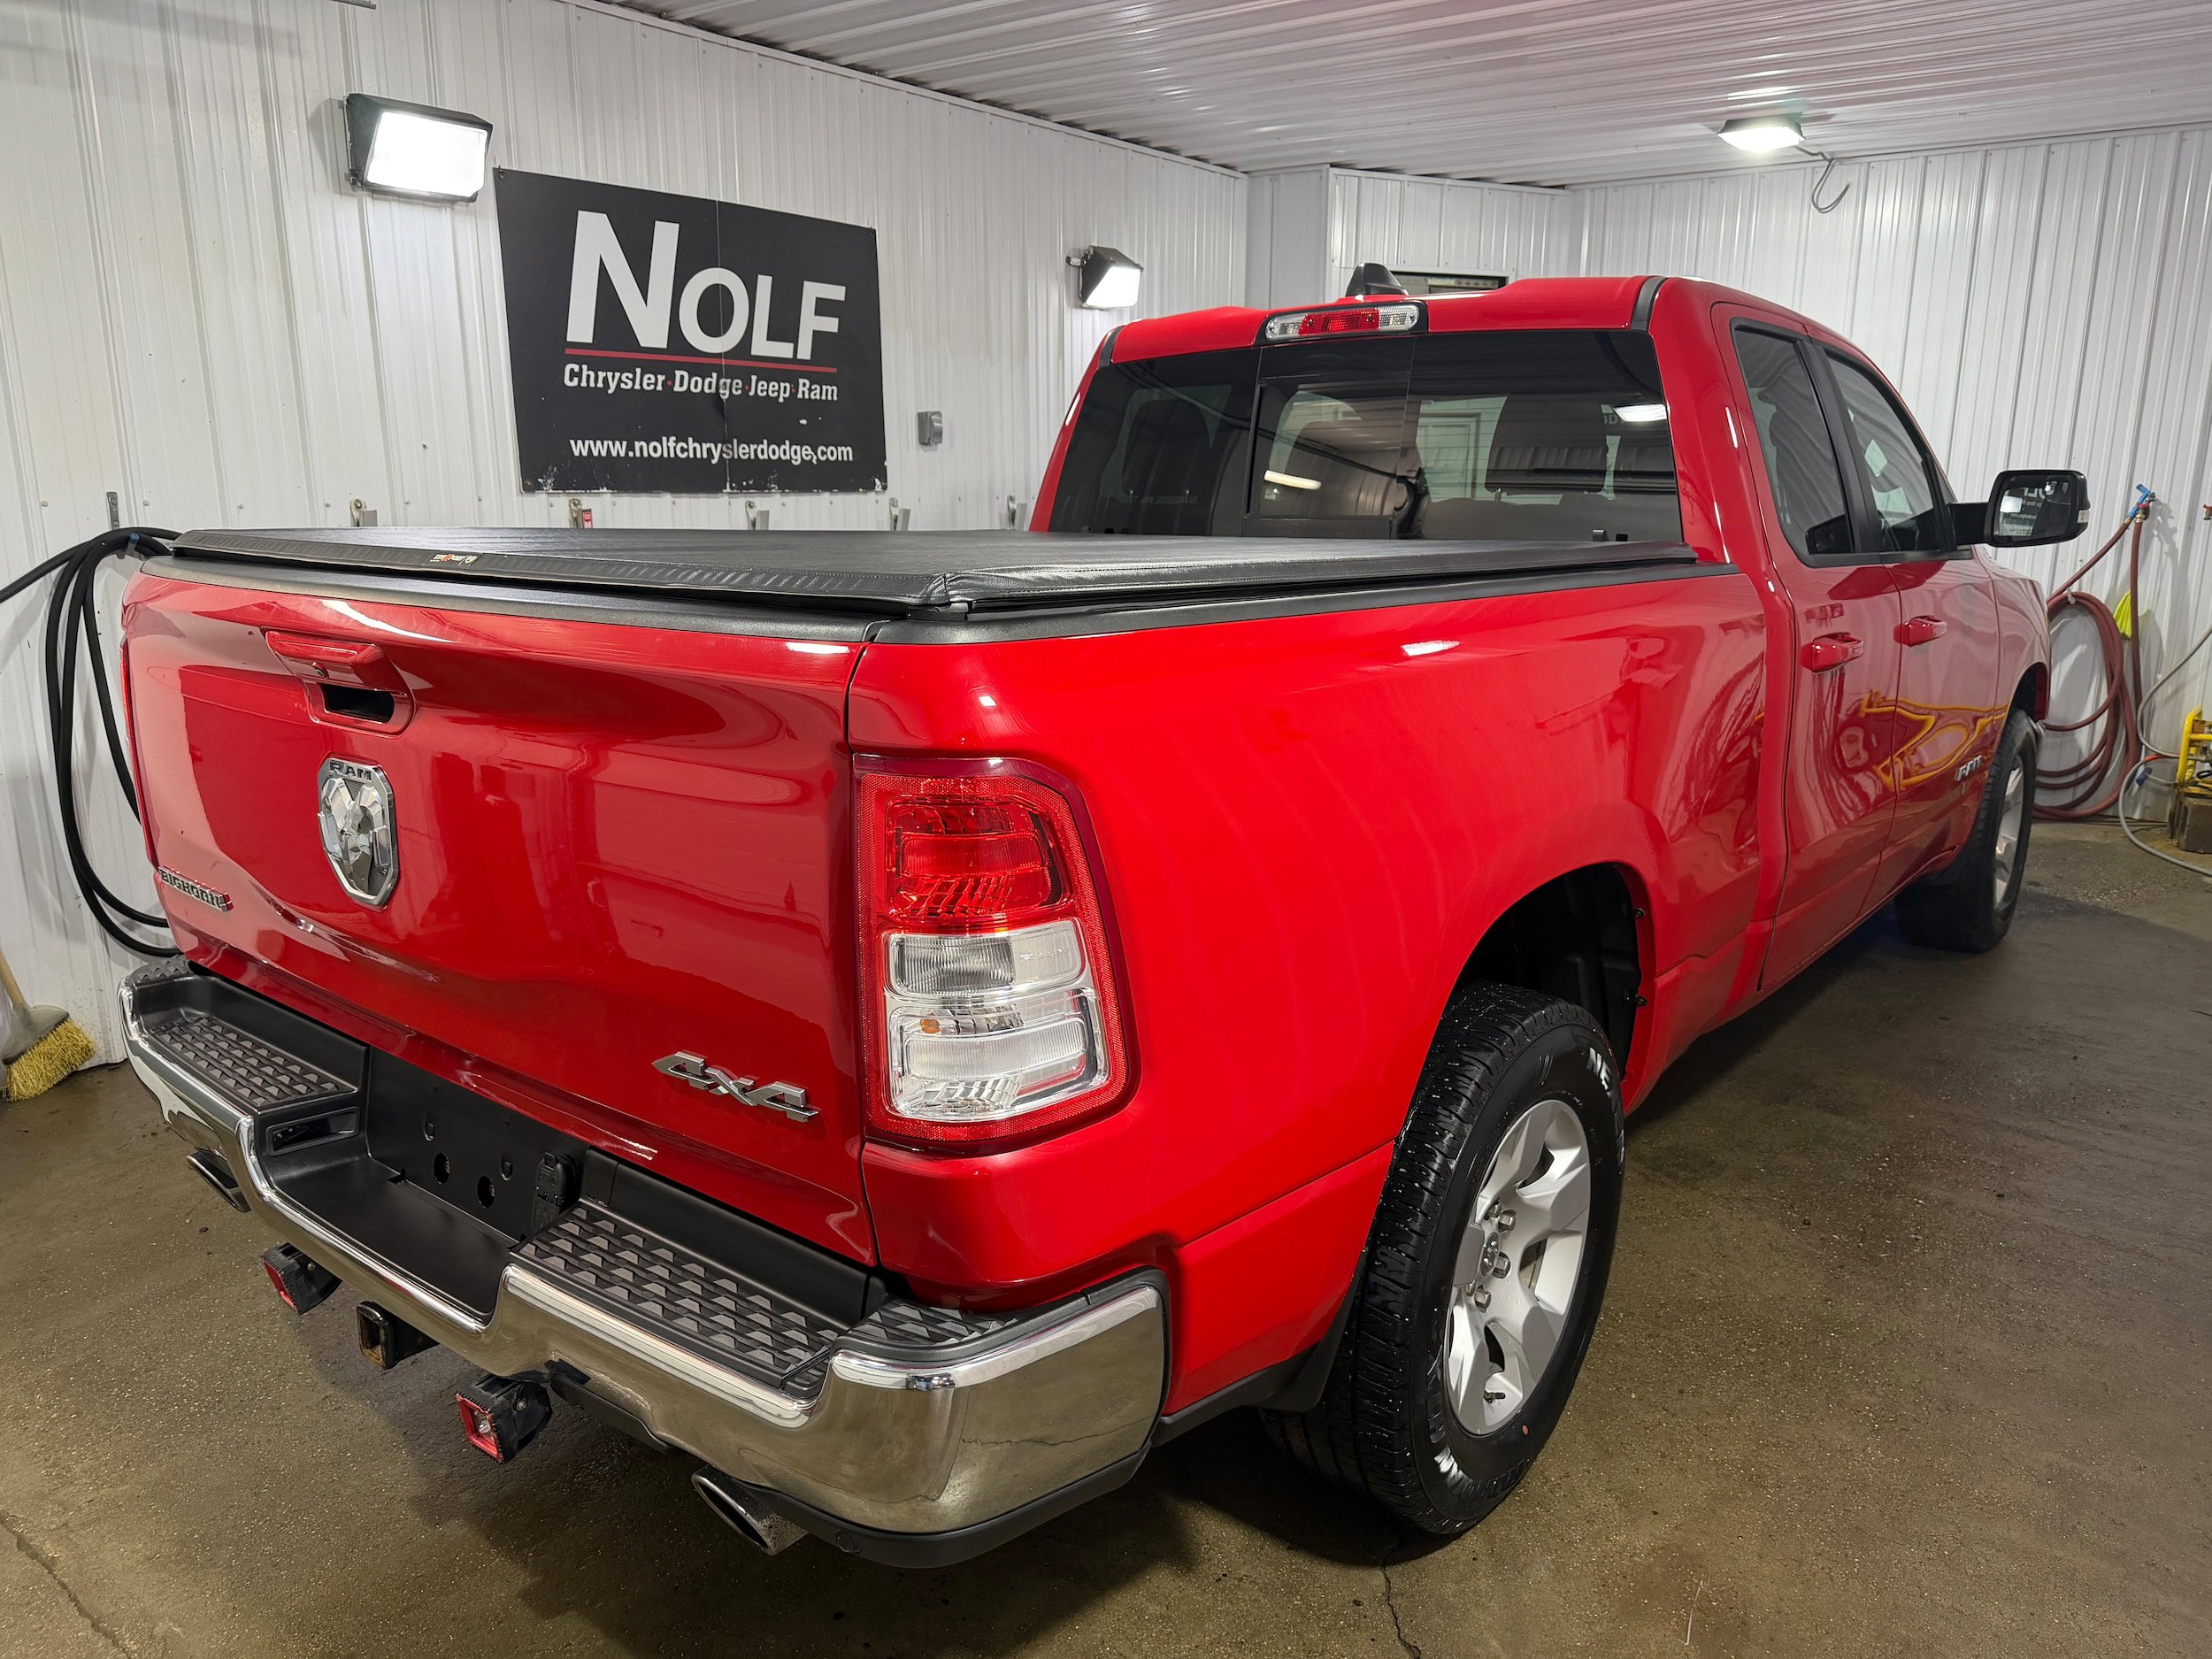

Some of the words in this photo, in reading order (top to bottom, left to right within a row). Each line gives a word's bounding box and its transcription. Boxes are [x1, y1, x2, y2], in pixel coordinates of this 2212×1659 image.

[566, 210, 846, 360] NOLF
[564, 363, 665, 395] Chrysler
[673, 370, 742, 399] Dodge
[749, 375, 791, 403] Jeep
[797, 379, 838, 401] Ram
[569, 436, 854, 465] www.nolfchryslerdodge.com
[328, 761, 372, 781] RAM
